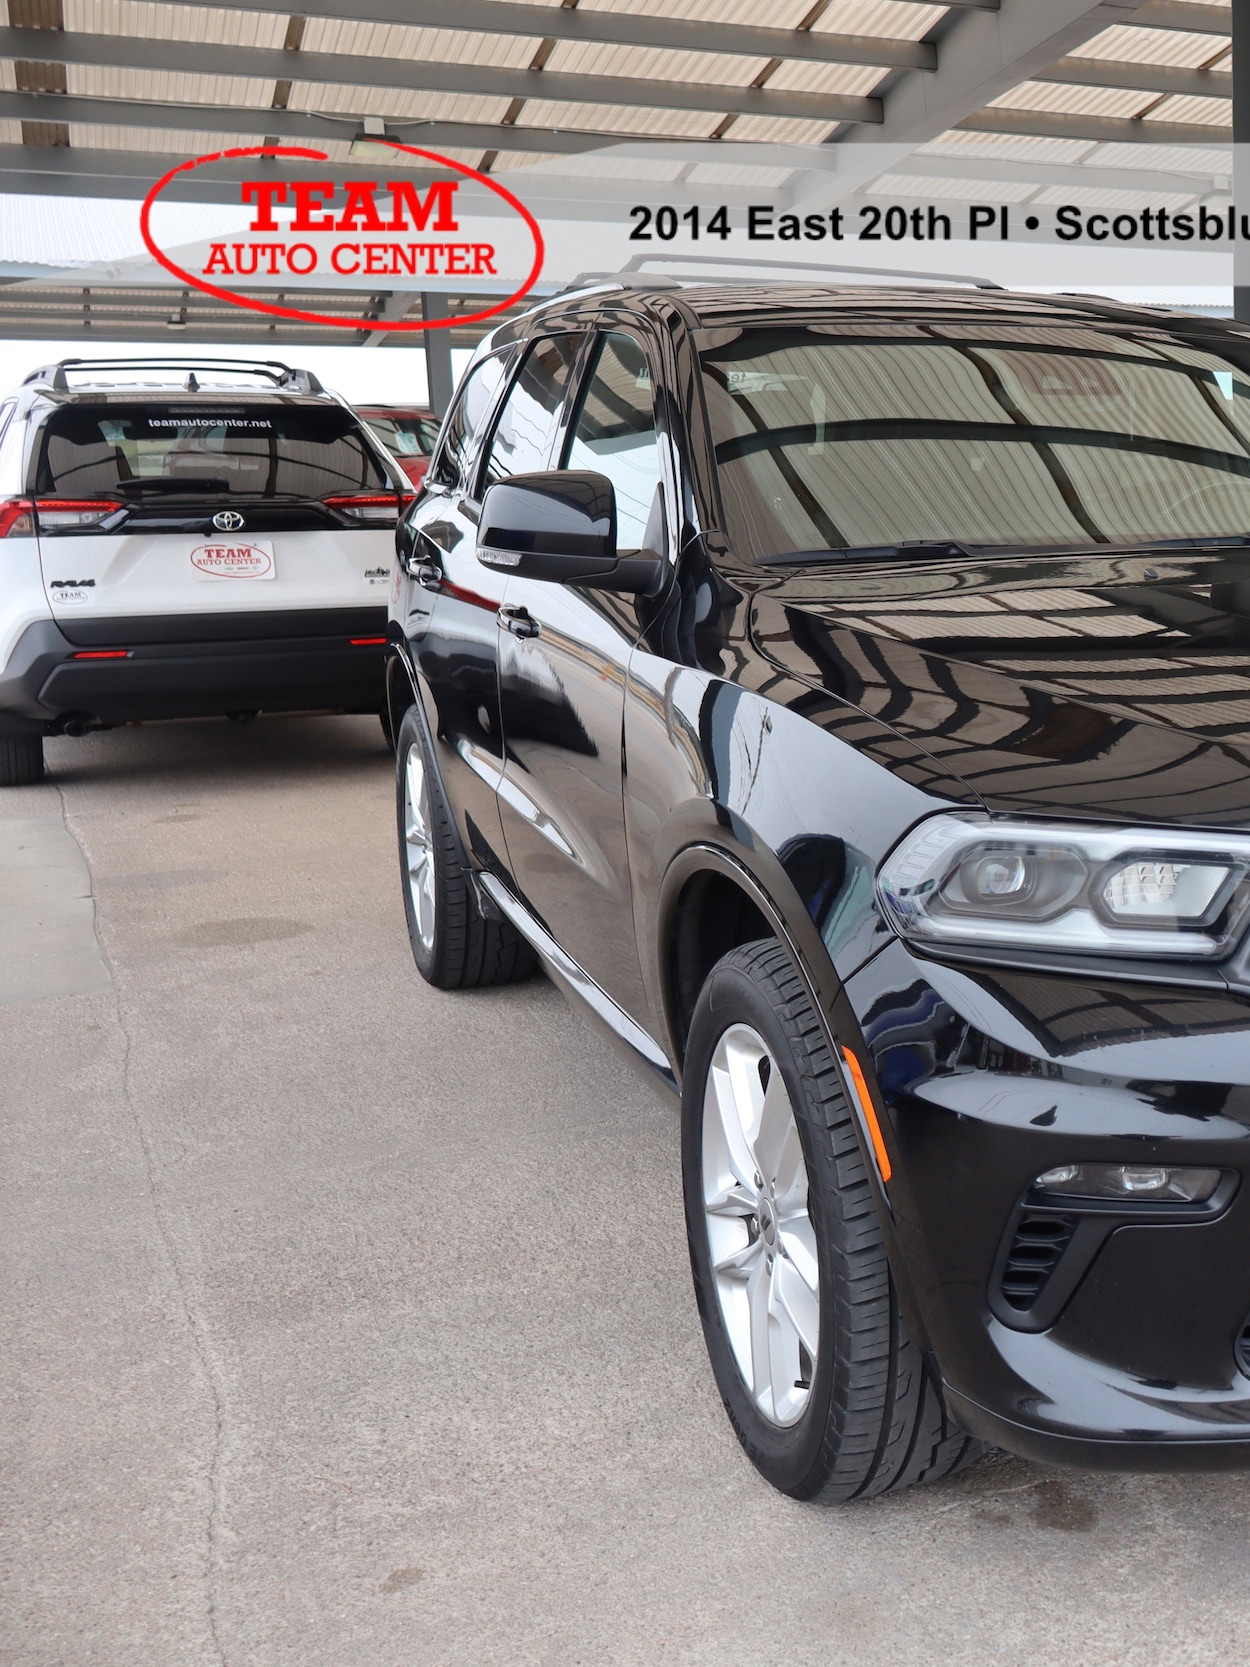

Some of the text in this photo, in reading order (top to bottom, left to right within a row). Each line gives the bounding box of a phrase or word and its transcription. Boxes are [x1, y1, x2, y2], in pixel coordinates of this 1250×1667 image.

[148, 418, 273, 428] teamautocenter.net
[204, 548, 252, 558] TEAM
[197, 558, 262, 566] AUTO CENTER
